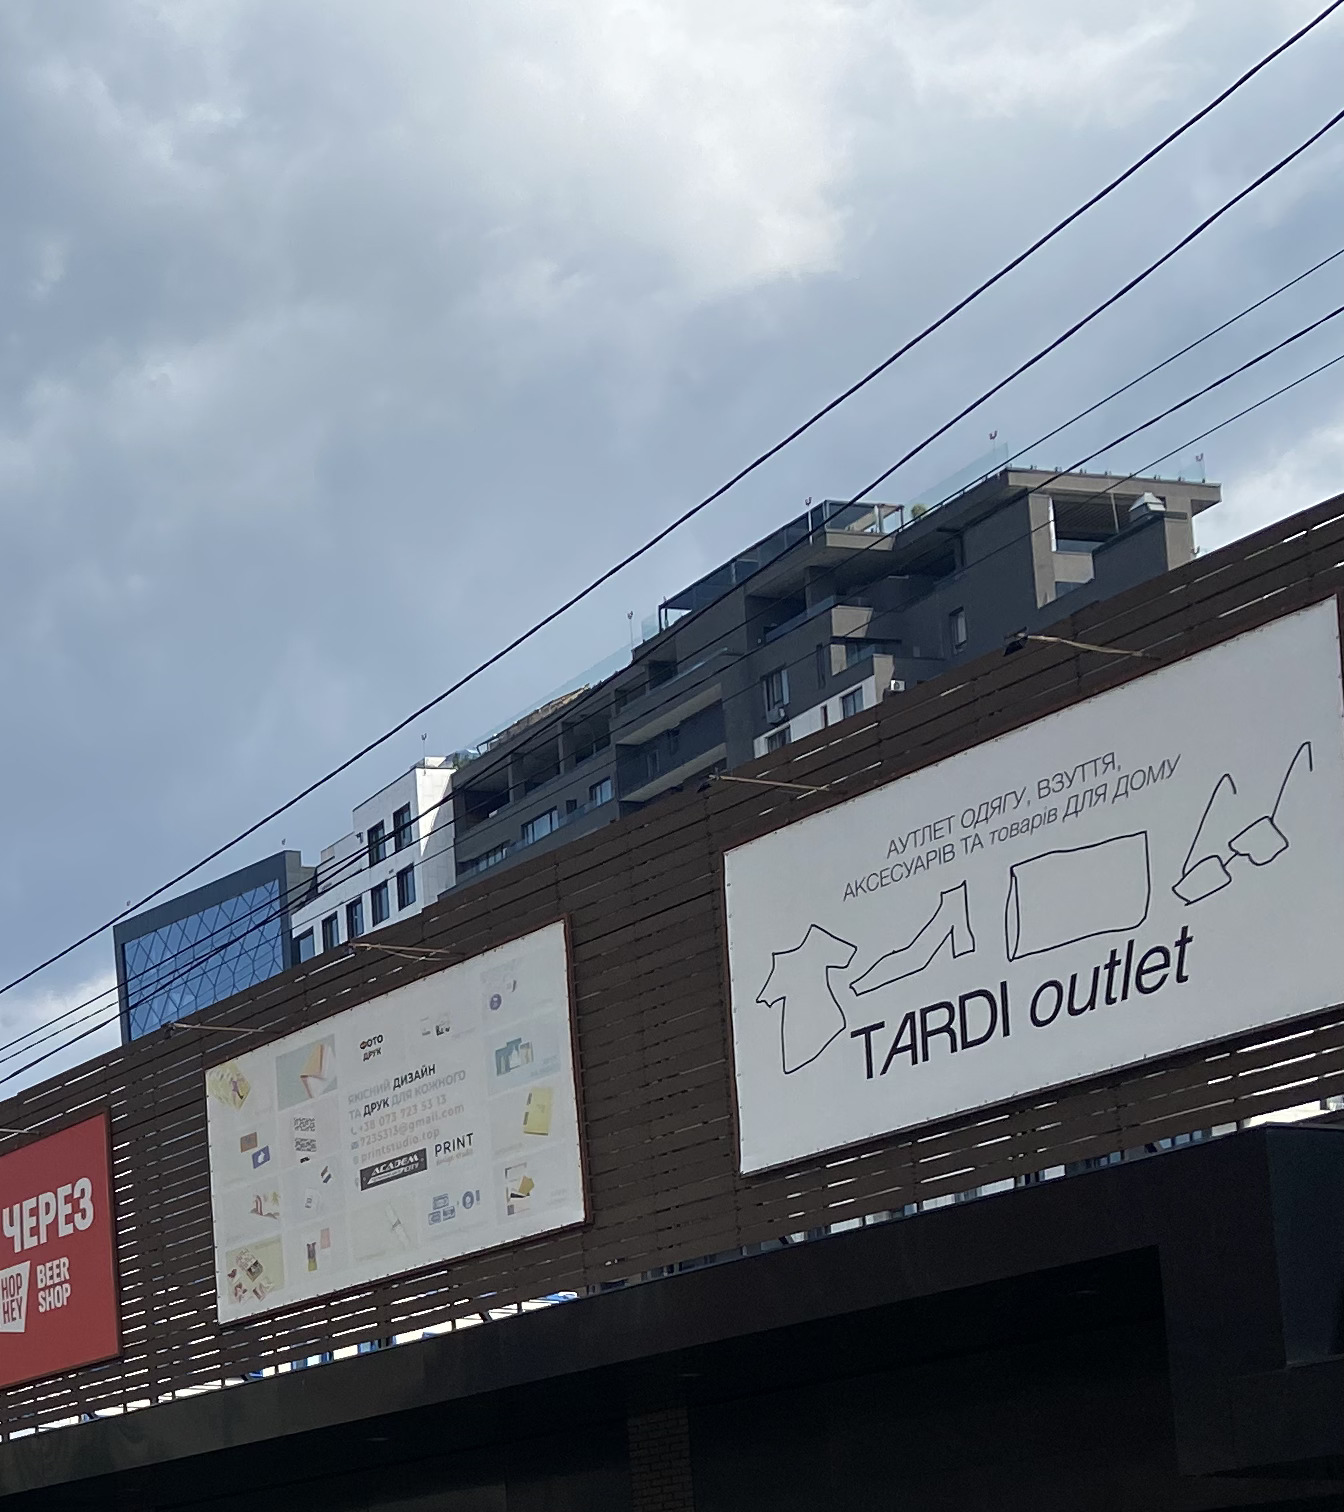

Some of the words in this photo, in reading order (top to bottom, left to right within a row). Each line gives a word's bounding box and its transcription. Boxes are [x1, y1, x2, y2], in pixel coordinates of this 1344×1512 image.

[886, 815, 956, 859] АУТЛЕТ
[961, 787, 1031, 829] ОДЯГУ,
[1037, 752, 1121, 800] ВЗУТТЯ,
[843, 843, 956, 901] АКСЕСУАРІВ
[961, 833, 985, 855] ТА
[990, 806, 1058, 846] товарів
[1062, 783, 1108, 823] ДЛЯ
[1112, 754, 1181, 804] ДОМУ
[850, 980, 1011, 1080] TARDI
[1030, 925, 1194, 1028] outlet
[359, 1034, 384, 1050] ФОТО
[362, 1047, 382, 1061] ДРУК
[392, 1064, 436, 1091] ДИЗАЙН
[348, 1109, 362, 1121] ТА
[363, 1097, 389, 1118] ДРУК
[391, 1089, 413, 1107] ДЛЯ
[414, 1069, 466, 1097] КОЖНОГО
[378, 1111, 397, 1127] 073
[400, 1104, 418, 1119] 723
[421, 1098, 433, 1111] 53
[361, 1127, 440, 1164] printstudio.top
[434, 1132, 474, 1158] PRINT
[371, 1152, 419, 1177] ACADEM
[2, 1177, 94, 1254] ЧЕРЕЗ
[1, 1272, 23, 1301] HOP
[36, 1256, 70, 1289] BEER
[2, 1296, 23, 1325] HEY
[38, 1283, 71, 1313] SHOP
